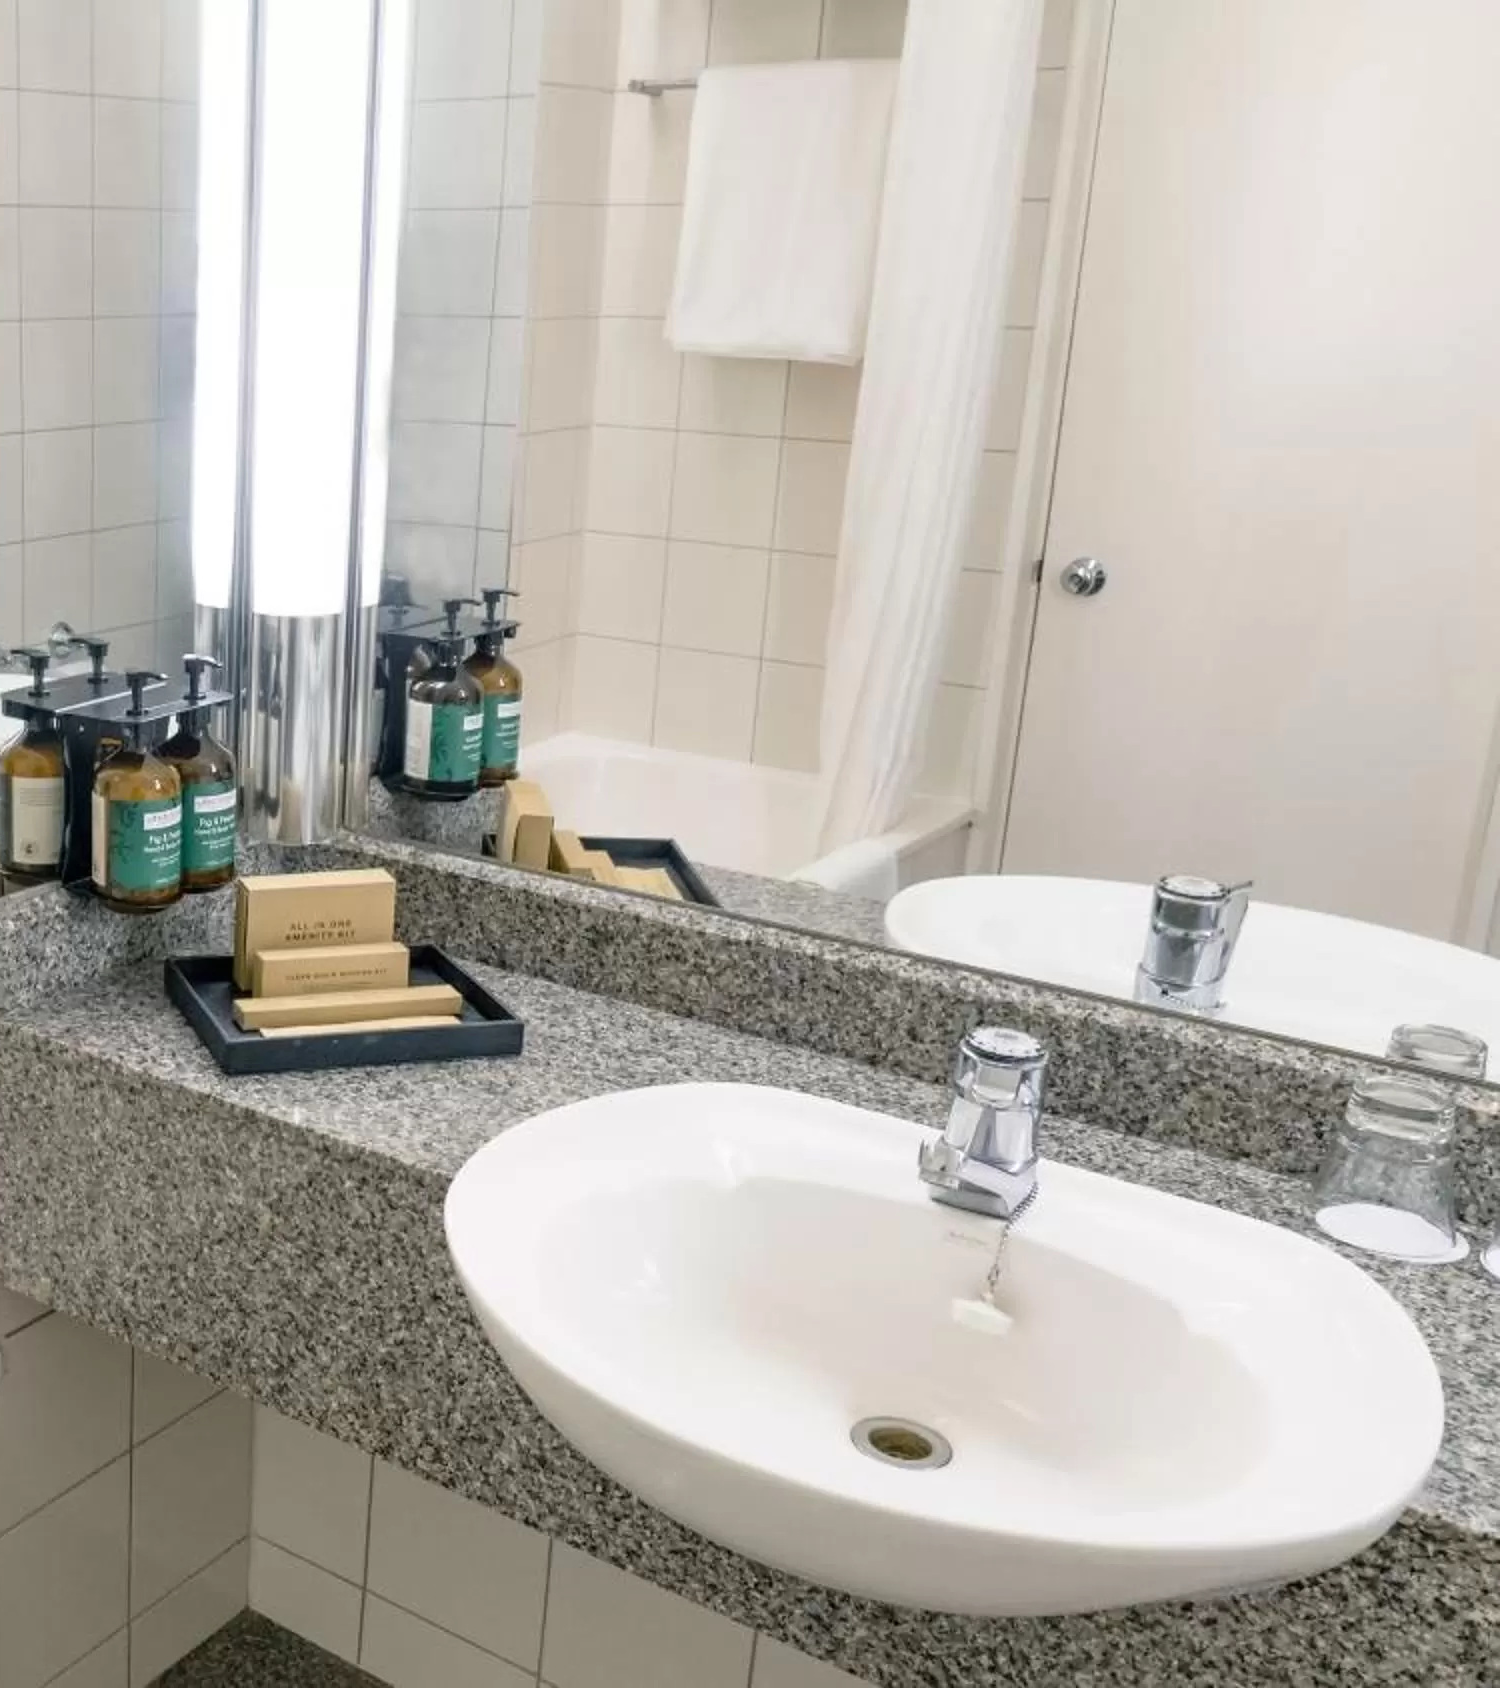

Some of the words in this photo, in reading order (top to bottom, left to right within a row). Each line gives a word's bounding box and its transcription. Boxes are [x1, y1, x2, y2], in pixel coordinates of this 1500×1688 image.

[290, 921, 308, 931] ALL
[328, 919, 352, 929] ONE
[285, 931, 333, 942] AMENITY
[338, 929, 356, 939] KIT
